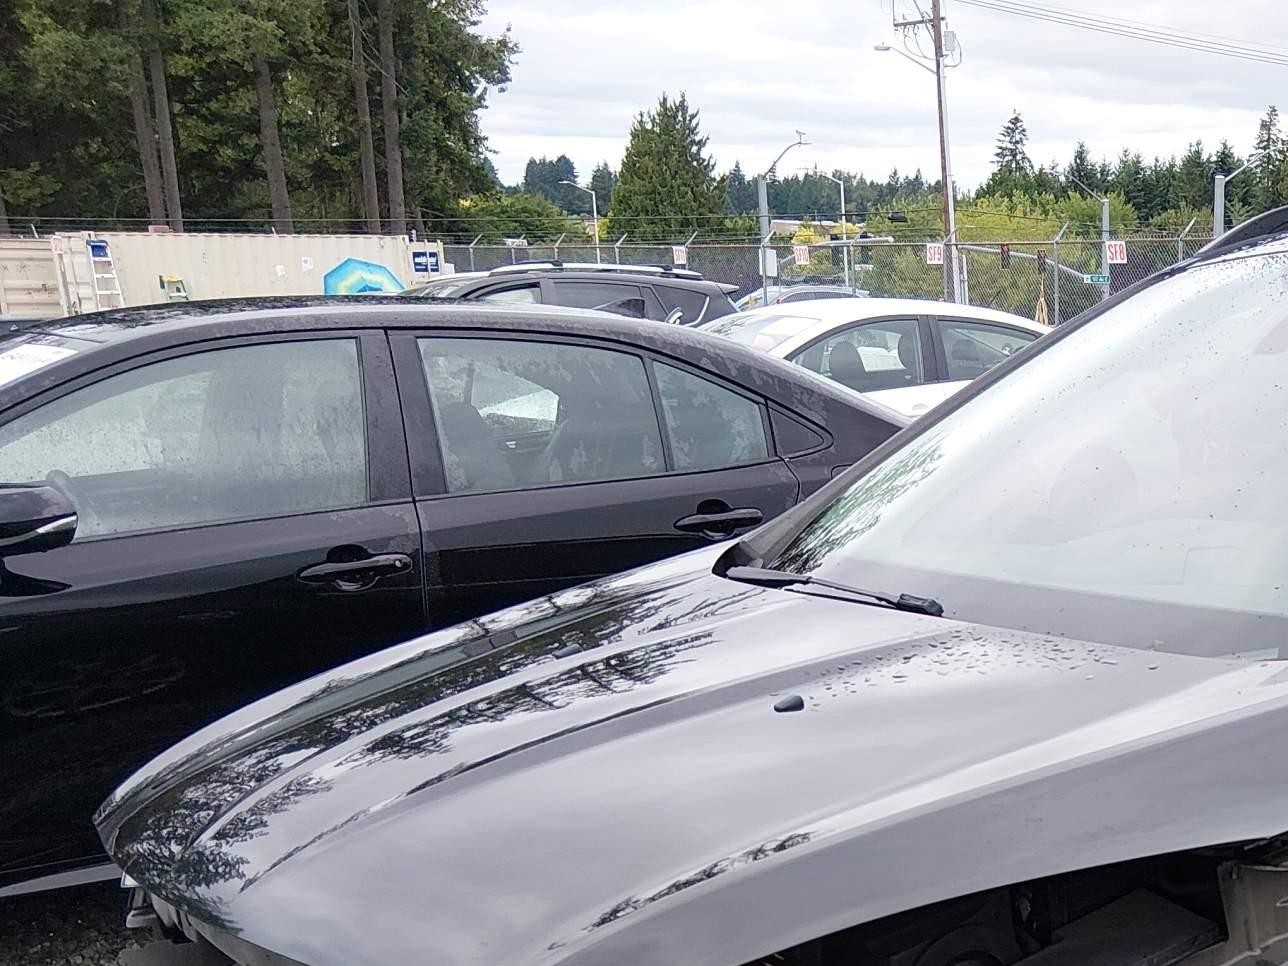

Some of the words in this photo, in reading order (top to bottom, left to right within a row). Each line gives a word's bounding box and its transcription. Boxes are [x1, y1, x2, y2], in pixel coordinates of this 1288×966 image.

[795, 247, 809, 262] SF10
[928, 246, 942, 262] SF9
[1107, 243, 1126, 261] SF8
